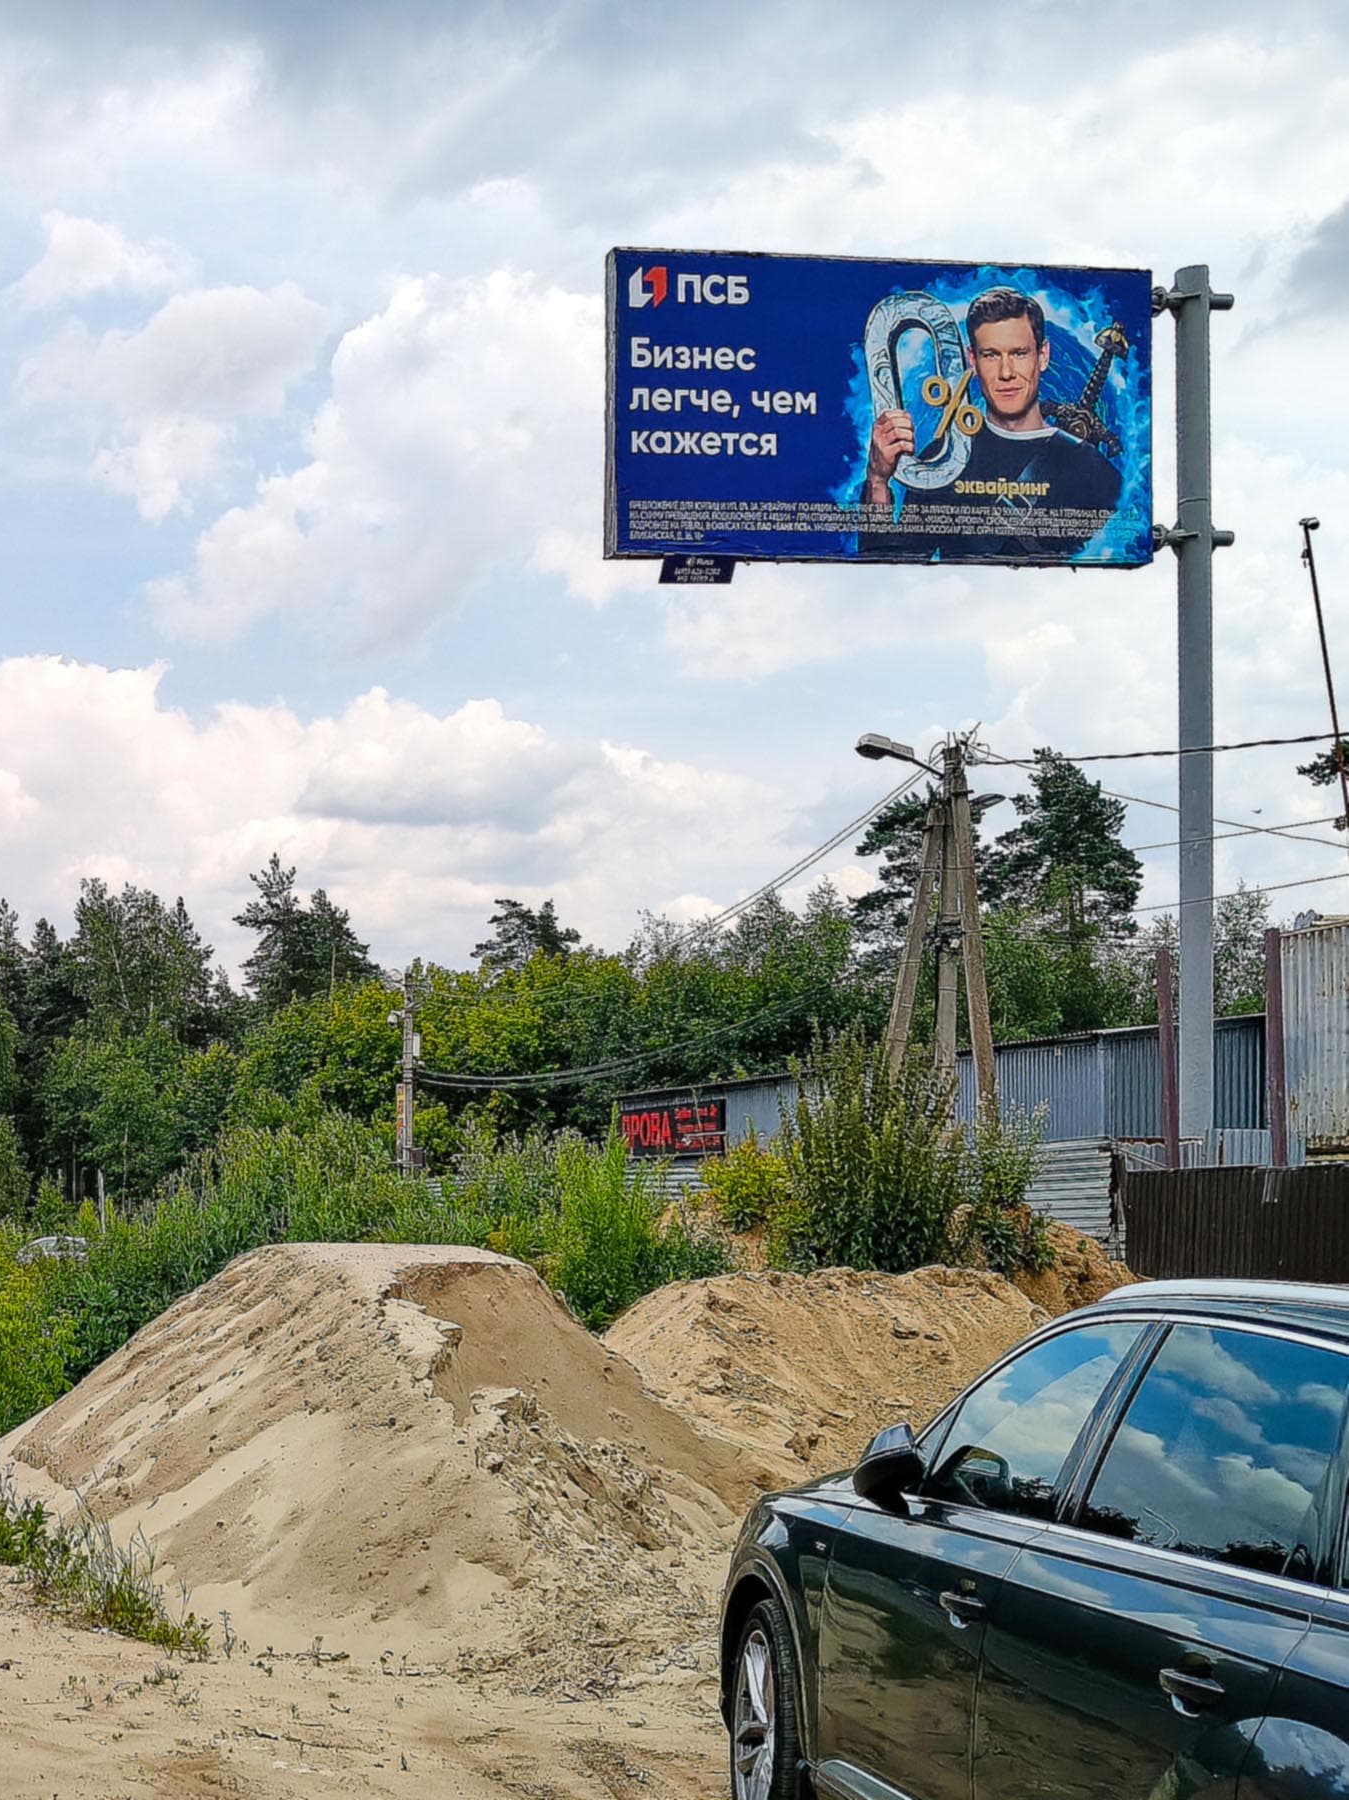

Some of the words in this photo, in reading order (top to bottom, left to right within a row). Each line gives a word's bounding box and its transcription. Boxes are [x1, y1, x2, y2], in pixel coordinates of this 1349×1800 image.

[677, 274, 749, 305] ПСБ
[630, 337, 756, 371] Бизнес
[629, 388, 740, 418] легче,
[751, 390, 817, 414] чем
[631, 430, 778, 456] кажется
[954, 478, 1050, 498] эквайринг
